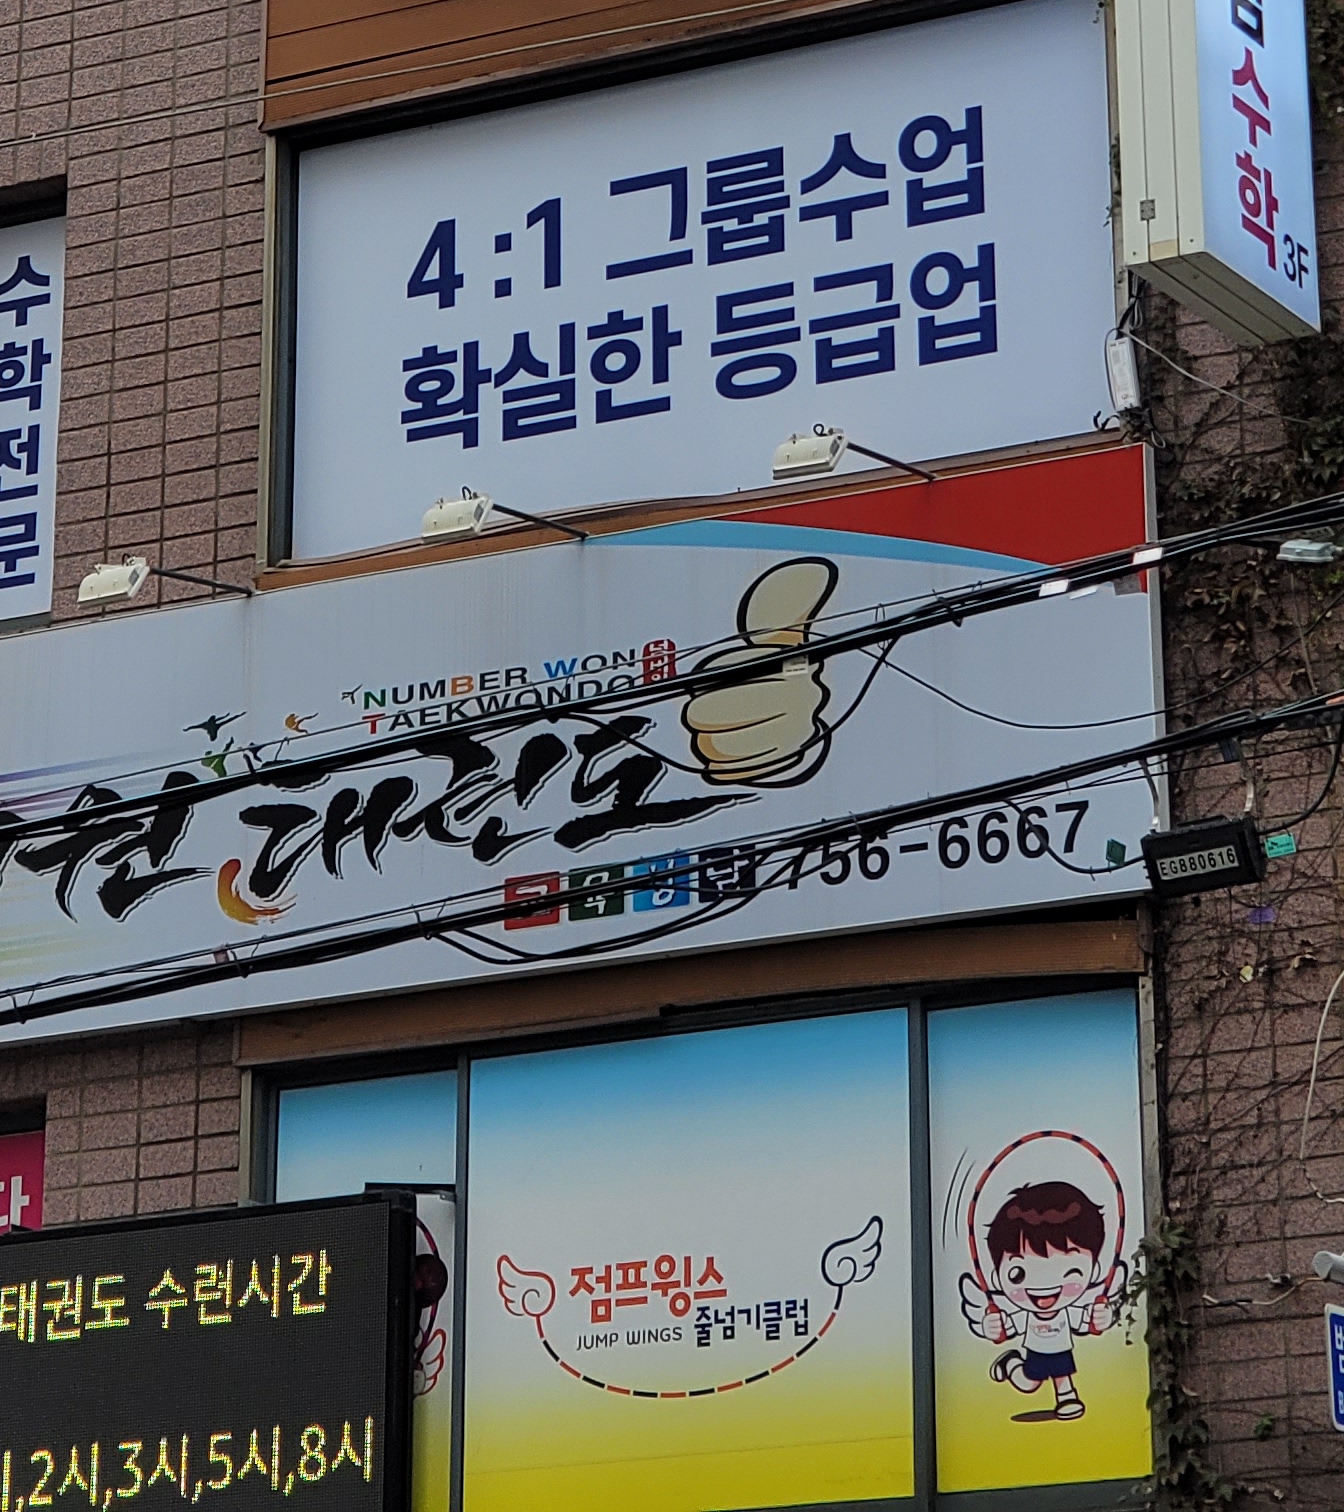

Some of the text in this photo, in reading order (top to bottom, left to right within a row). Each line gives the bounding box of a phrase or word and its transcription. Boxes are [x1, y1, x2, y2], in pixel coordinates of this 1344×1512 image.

[603, 105, 987, 282] 그룹수업
[1283, 233, 1310, 289] 3F
[400, 242, 1000, 450] 확실한 등급업
[362, 648, 637, 711] NUMBER WON
[1159, 847, 1237, 877] EG880616
[144, 1247, 333, 1330] 수련시간
[568, 1254, 728, 1324] 점프윙스
[576, 1326, 683, 1351] JUMP WINGS
[693, 1298, 809, 1348] 줄넘기클럽
